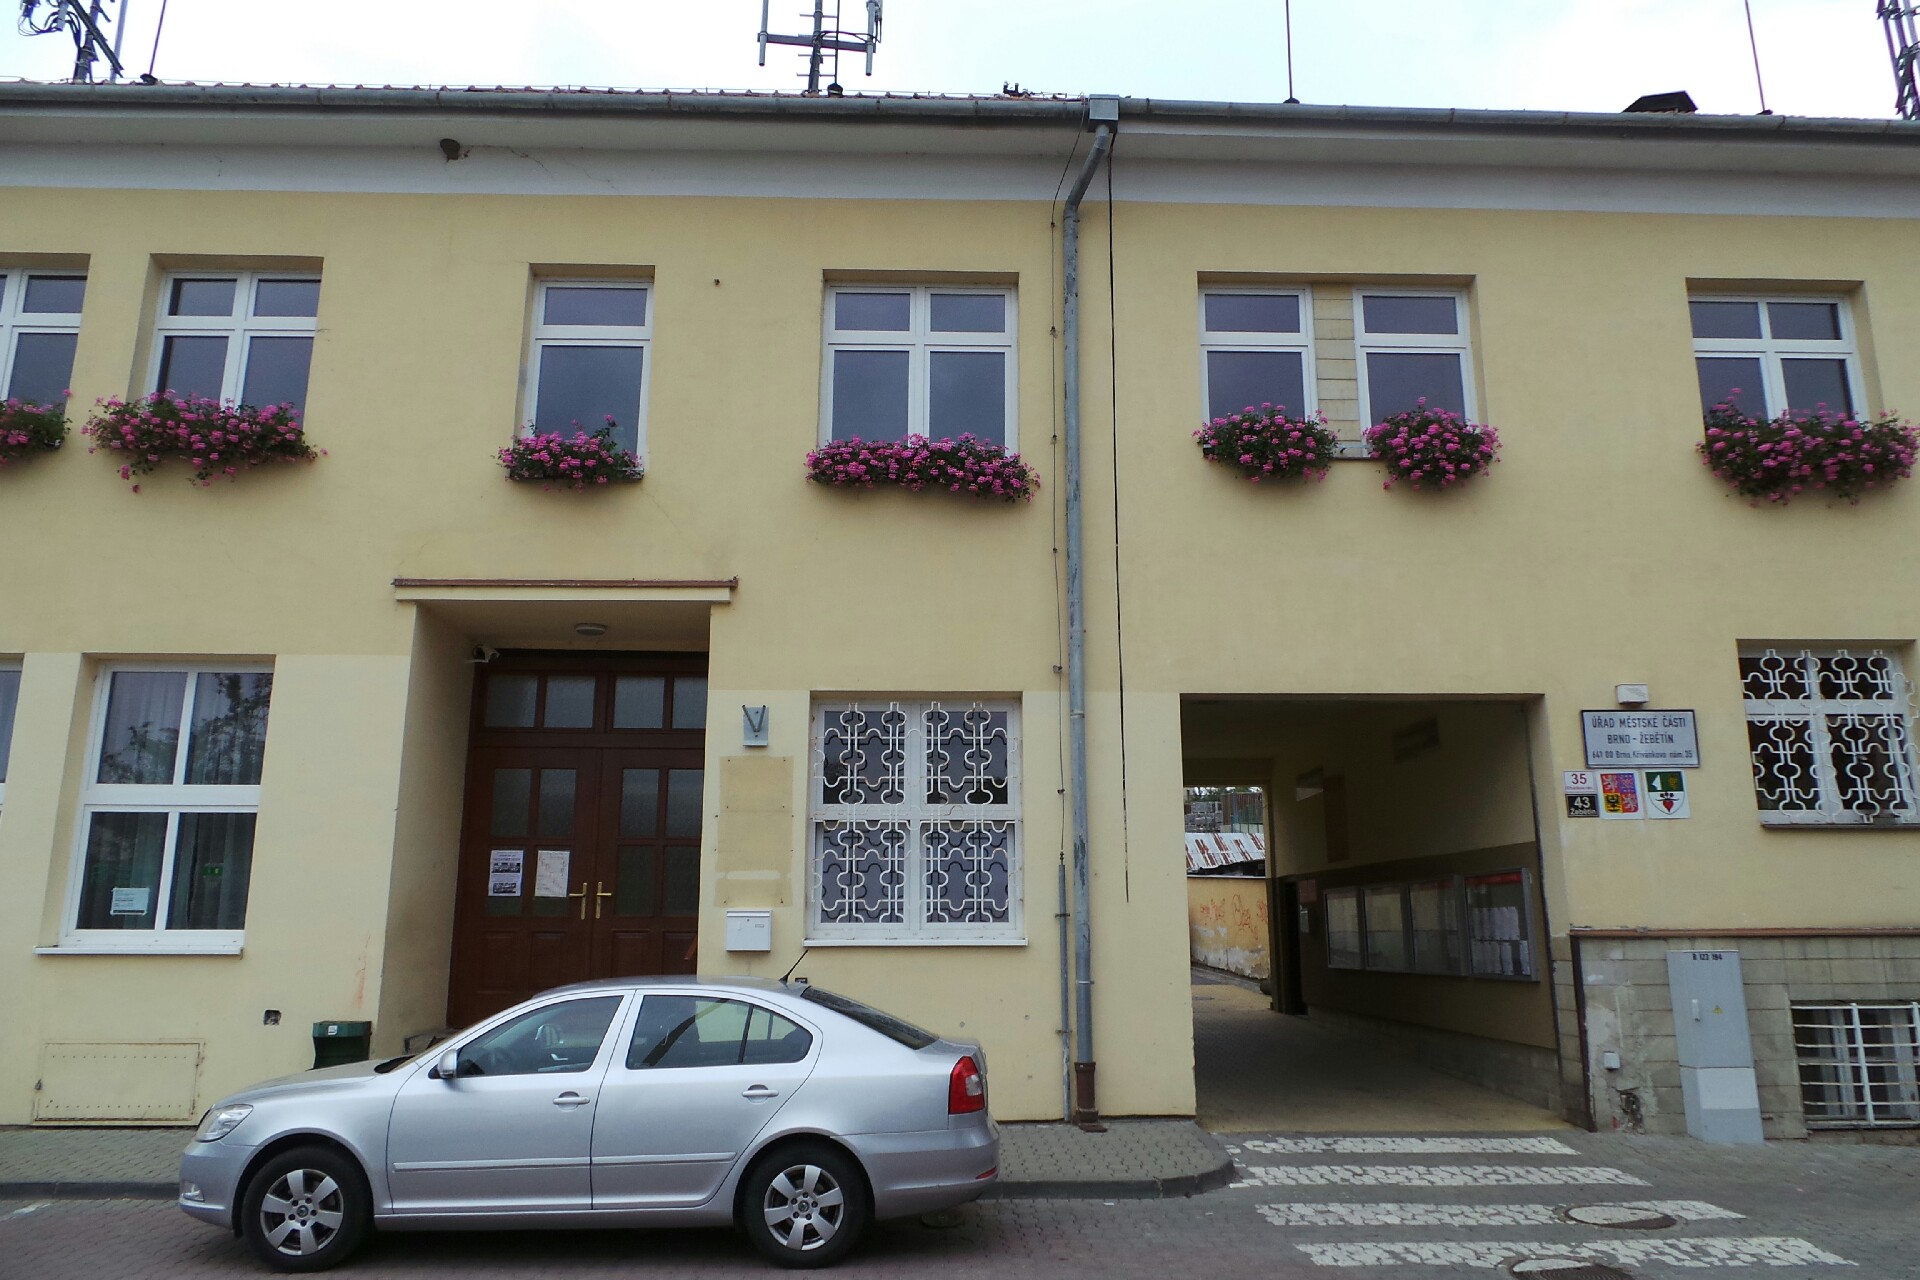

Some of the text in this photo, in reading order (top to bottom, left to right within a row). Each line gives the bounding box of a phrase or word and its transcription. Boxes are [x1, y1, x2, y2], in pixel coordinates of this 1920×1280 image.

[1592, 715, 1686, 728] ÚŘAD MĚSTSKÉ ČÁSTI
[1607, 734, 1631, 744] BRNO
[1639, 732, 1674, 744] ŽEBĚTÍN
[1571, 773, 1587, 785] 35
[1574, 796, 1591, 808] 43
